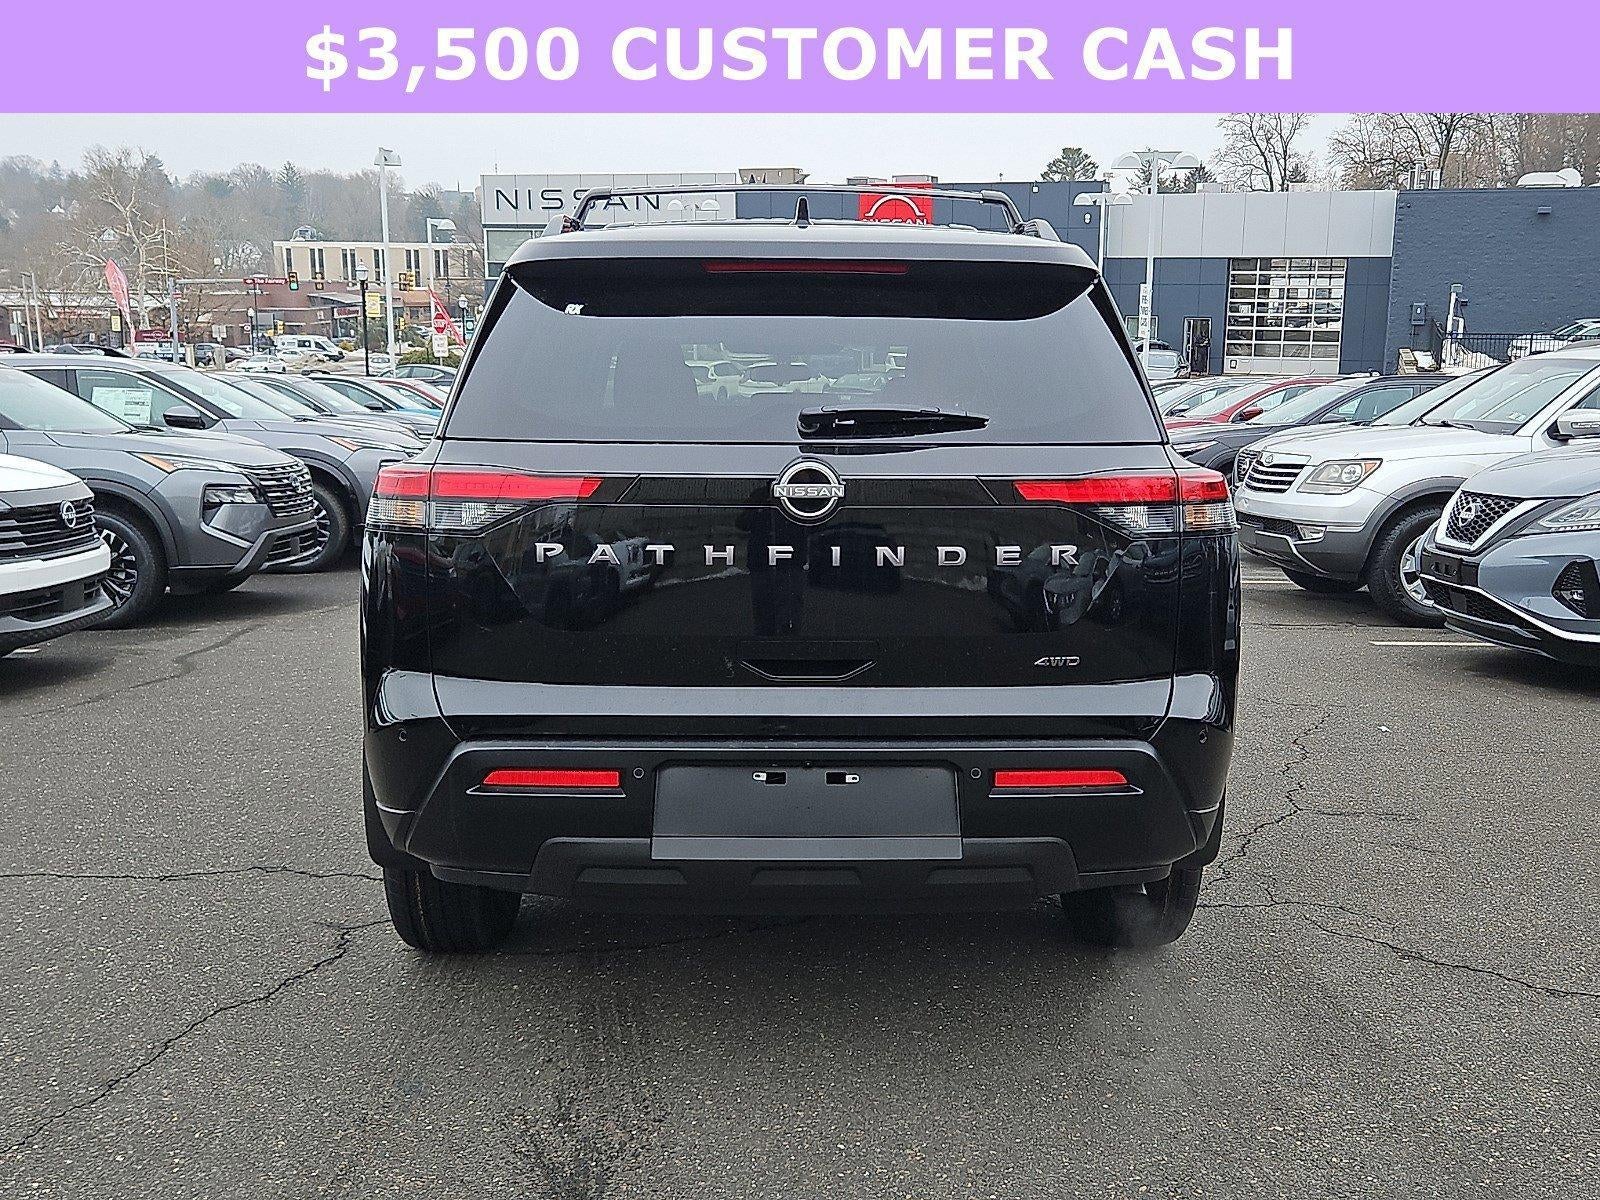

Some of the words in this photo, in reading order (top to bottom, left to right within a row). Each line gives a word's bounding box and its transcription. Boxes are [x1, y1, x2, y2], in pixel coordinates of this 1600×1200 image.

[565, 303, 585, 315] RX
[776, 486, 843, 497] NISSAN
[534, 542, 1081, 566] PATHFINDER
[1034, 656, 1080, 666] 4WD
